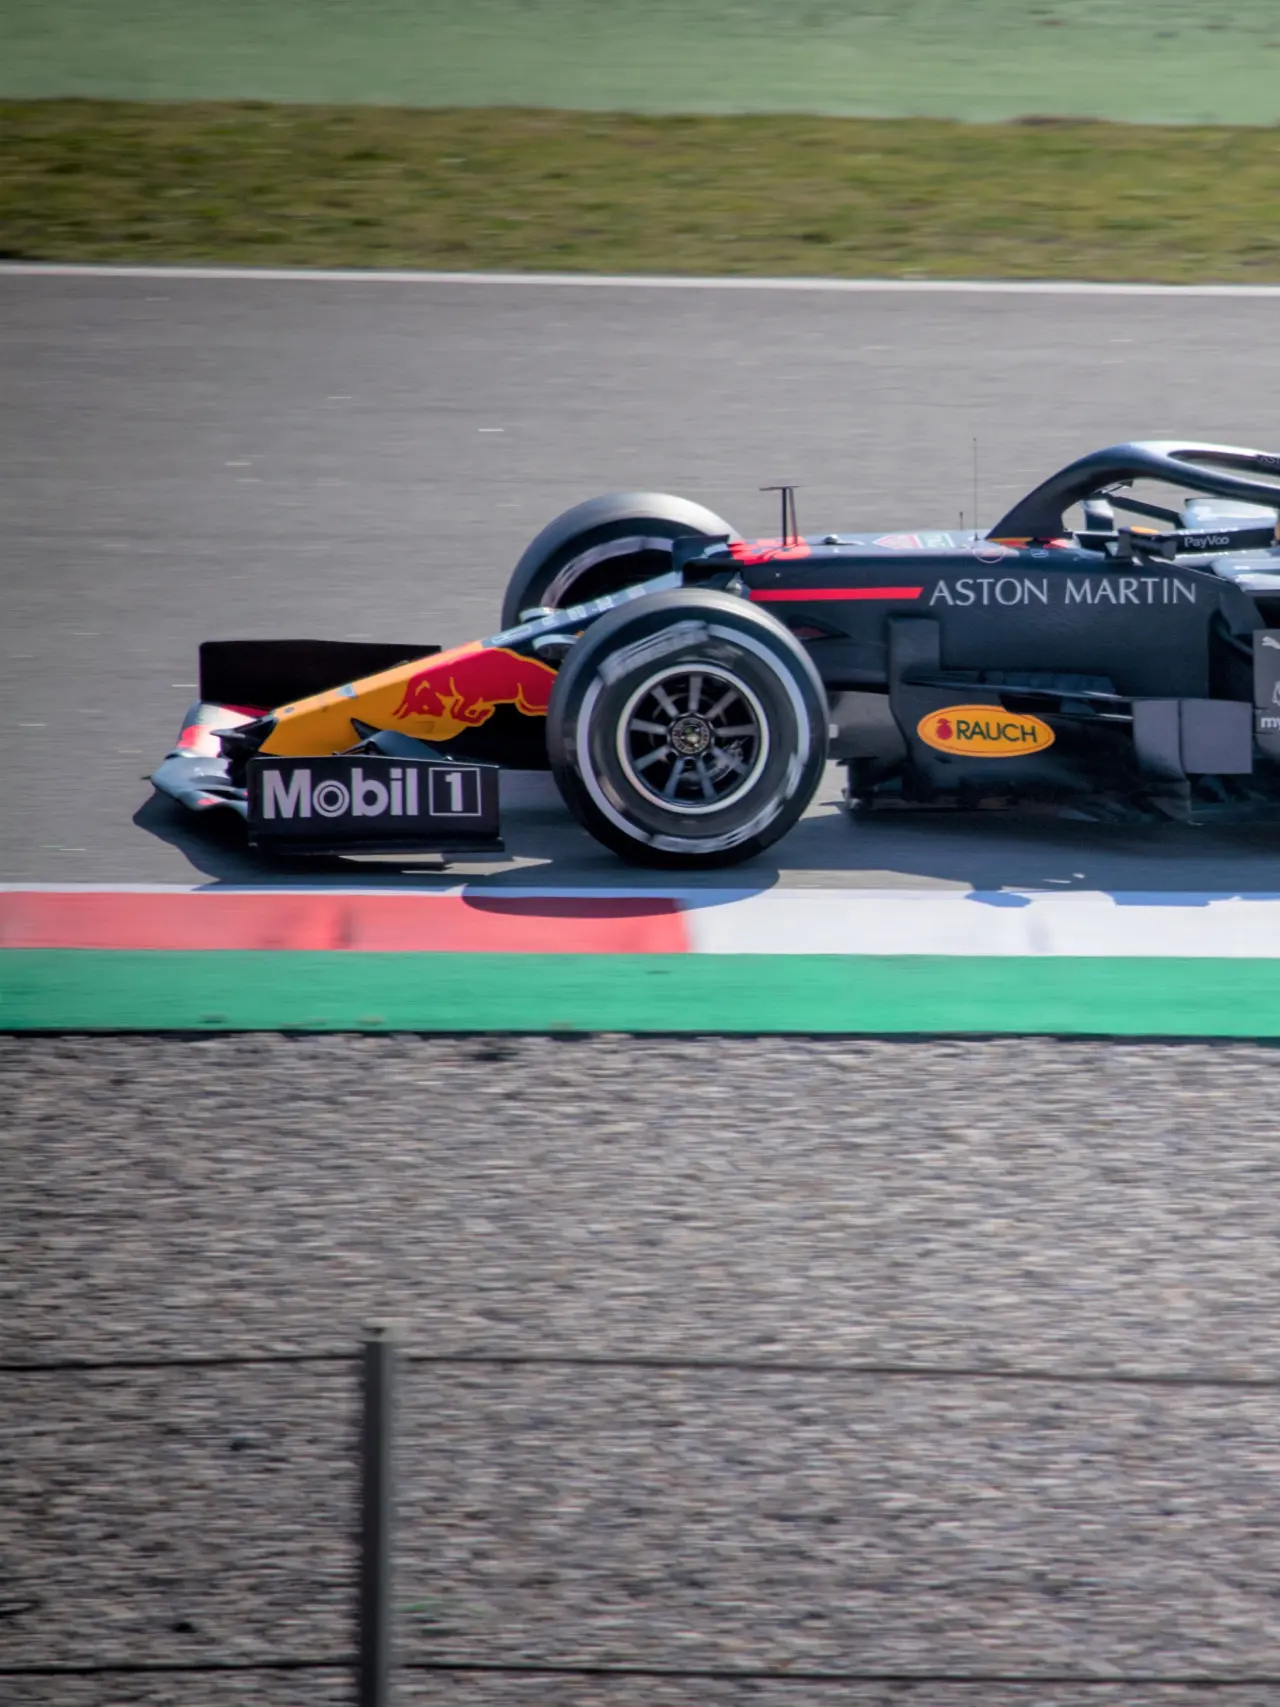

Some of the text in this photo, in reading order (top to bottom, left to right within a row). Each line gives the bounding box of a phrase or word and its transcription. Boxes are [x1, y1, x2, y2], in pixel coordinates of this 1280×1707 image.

[929, 578, 1198, 606] ASTON MARTIN
[955, 719, 1038, 743] RAUCH
[262, 768, 418, 819] Mobil
